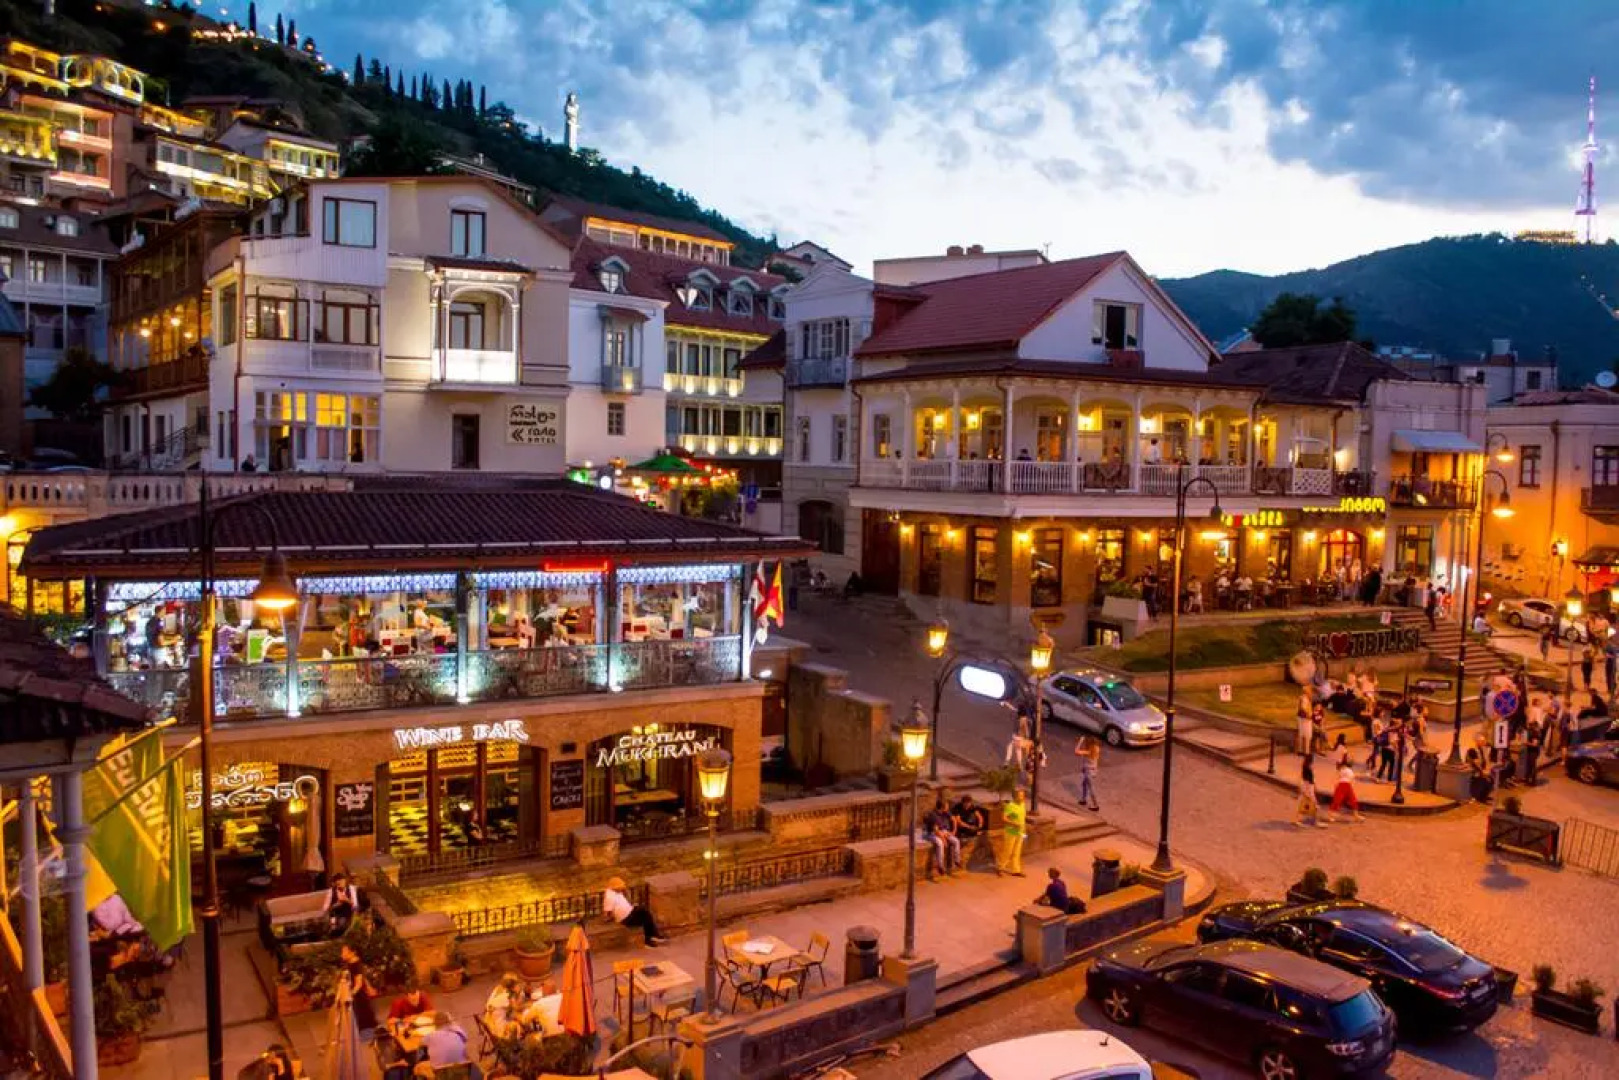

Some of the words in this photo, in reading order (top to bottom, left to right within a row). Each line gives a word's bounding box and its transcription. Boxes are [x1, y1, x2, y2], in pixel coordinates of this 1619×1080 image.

[394, 726, 462, 749] WINE
[472, 720, 529, 744] BAR
[619, 730, 697, 749] CHATEAU
[596, 736, 716, 768] MUKHRANI
